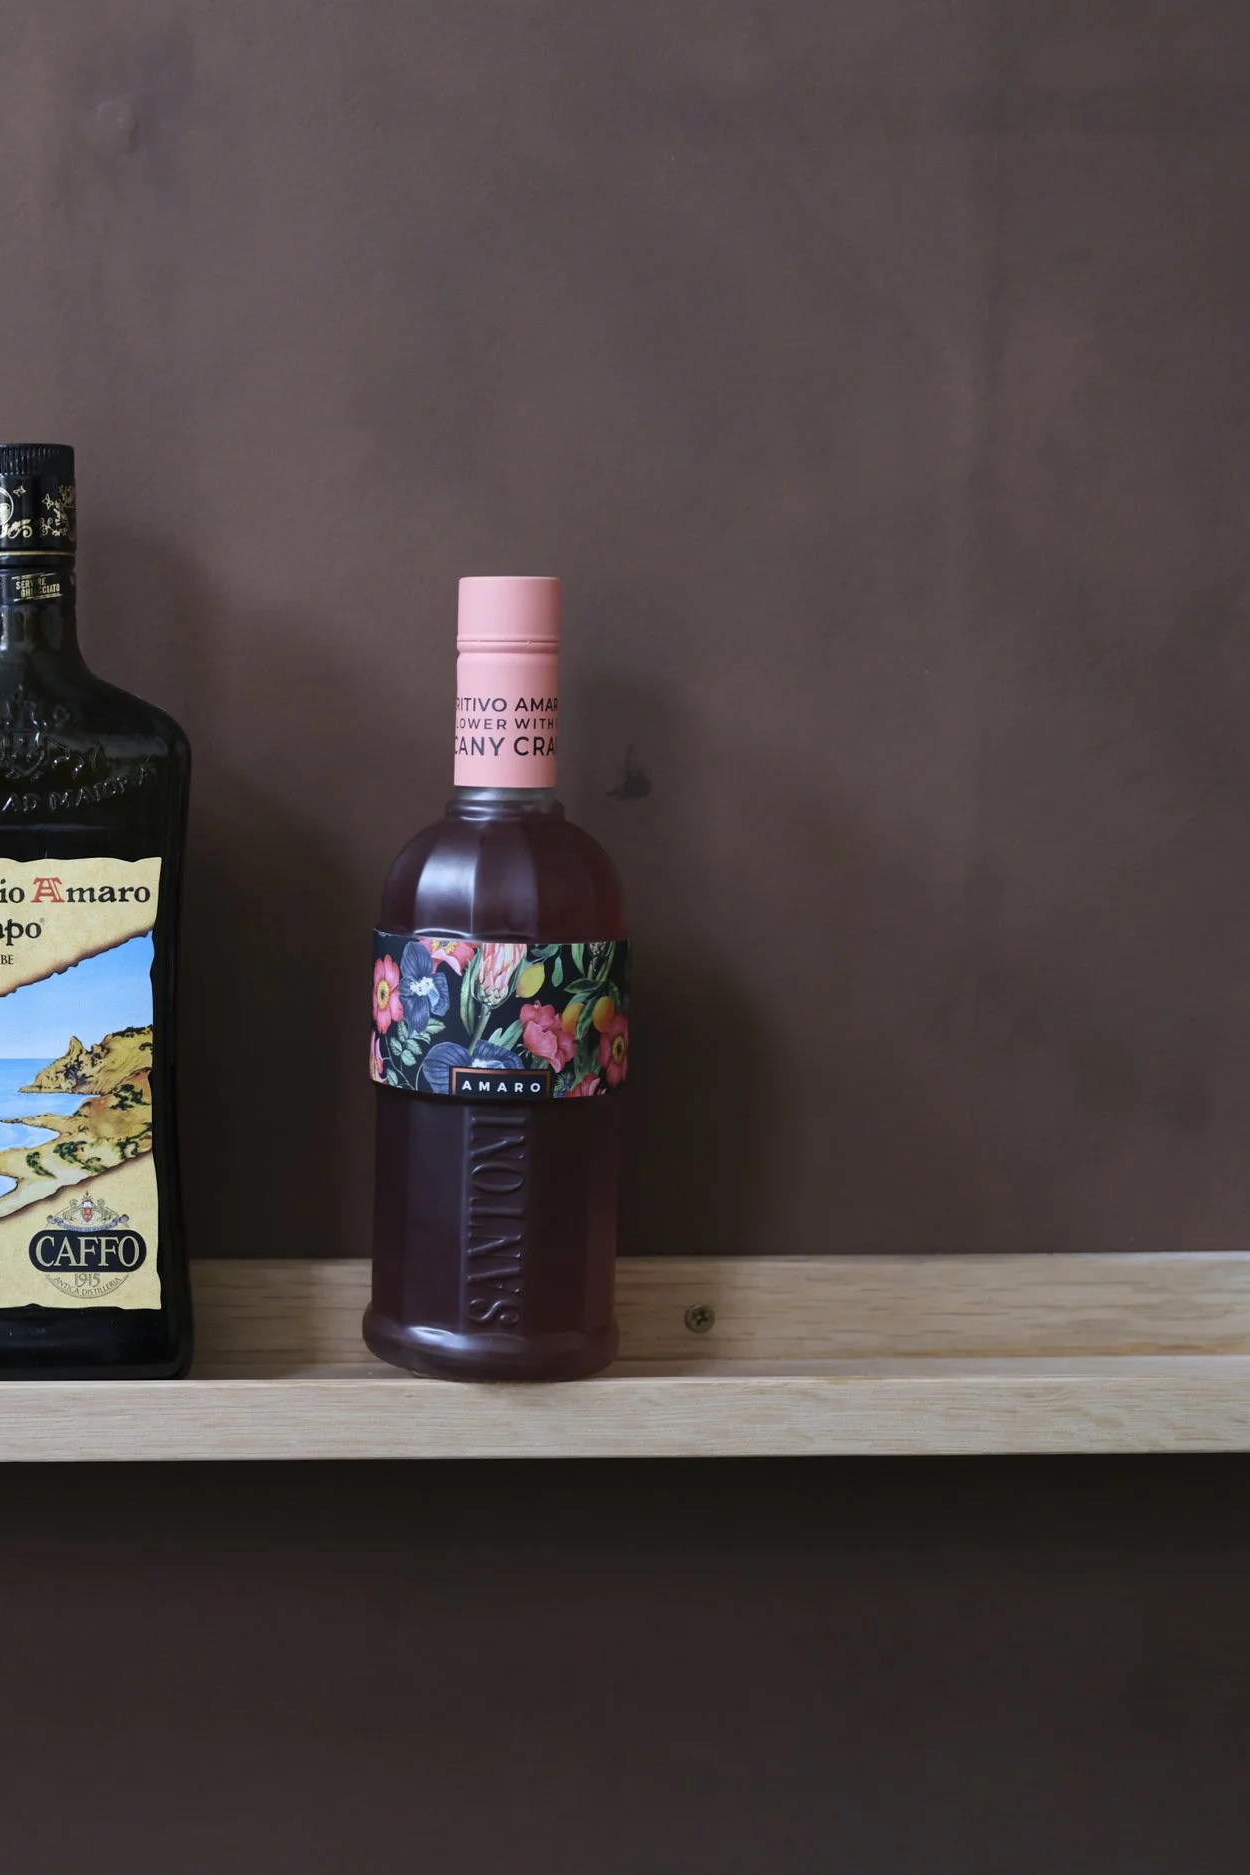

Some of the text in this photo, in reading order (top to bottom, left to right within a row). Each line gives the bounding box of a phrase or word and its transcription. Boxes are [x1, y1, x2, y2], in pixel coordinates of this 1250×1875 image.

[513, 736, 558, 757] CRA
[30, 876, 151, 904] Amaro
[462, 1079, 541, 1093] AMARO
[466, 1116, 526, 1325] SANTONI
[35, 1235, 140, 1268] CAFFO
[54, 1276, 80, 1295] ANTICA
[74, 1272, 101, 1288] 1915
